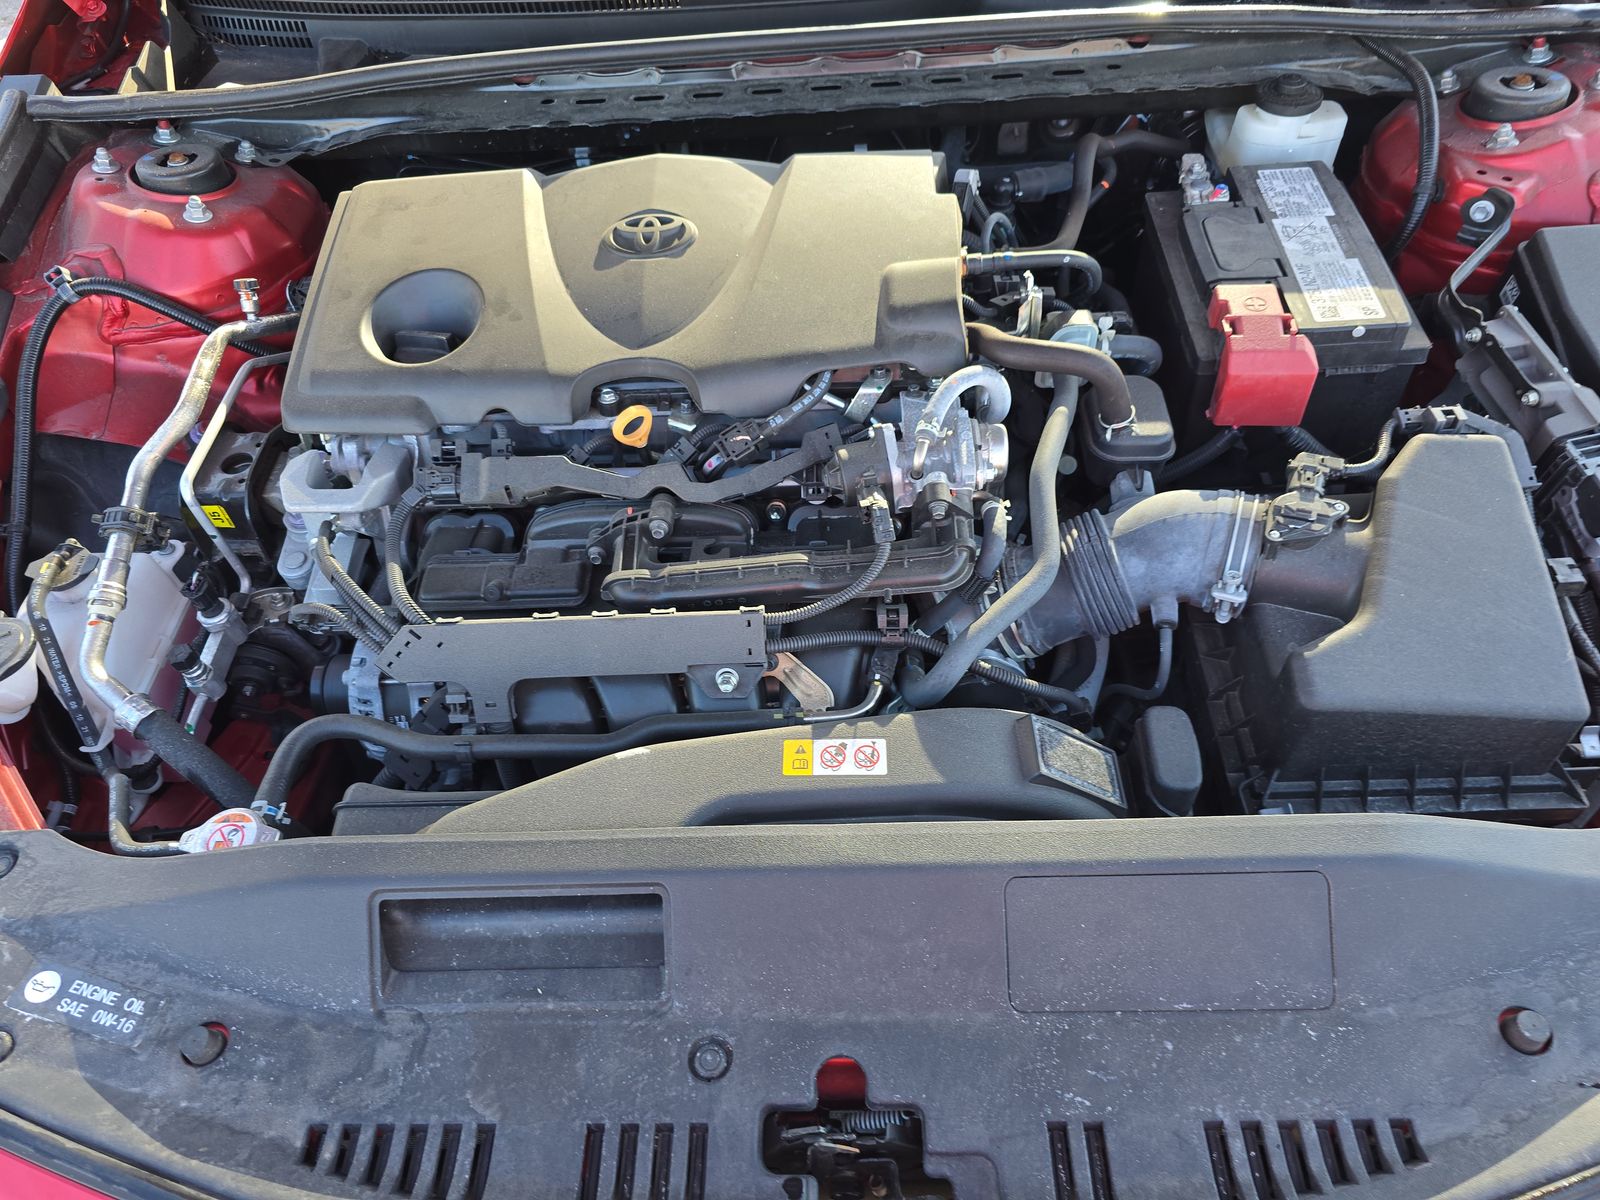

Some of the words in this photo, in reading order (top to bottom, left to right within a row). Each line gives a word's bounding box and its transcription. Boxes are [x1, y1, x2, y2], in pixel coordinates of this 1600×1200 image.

[208, 511, 225, 524] J5
[48, 647, 62, 670] WATER
[68, 980, 121, 1006] ENGINE
[123, 997, 146, 1016] OIL
[56, 997, 89, 1018] SAE
[91, 1009, 136, 1033] 0W-16
